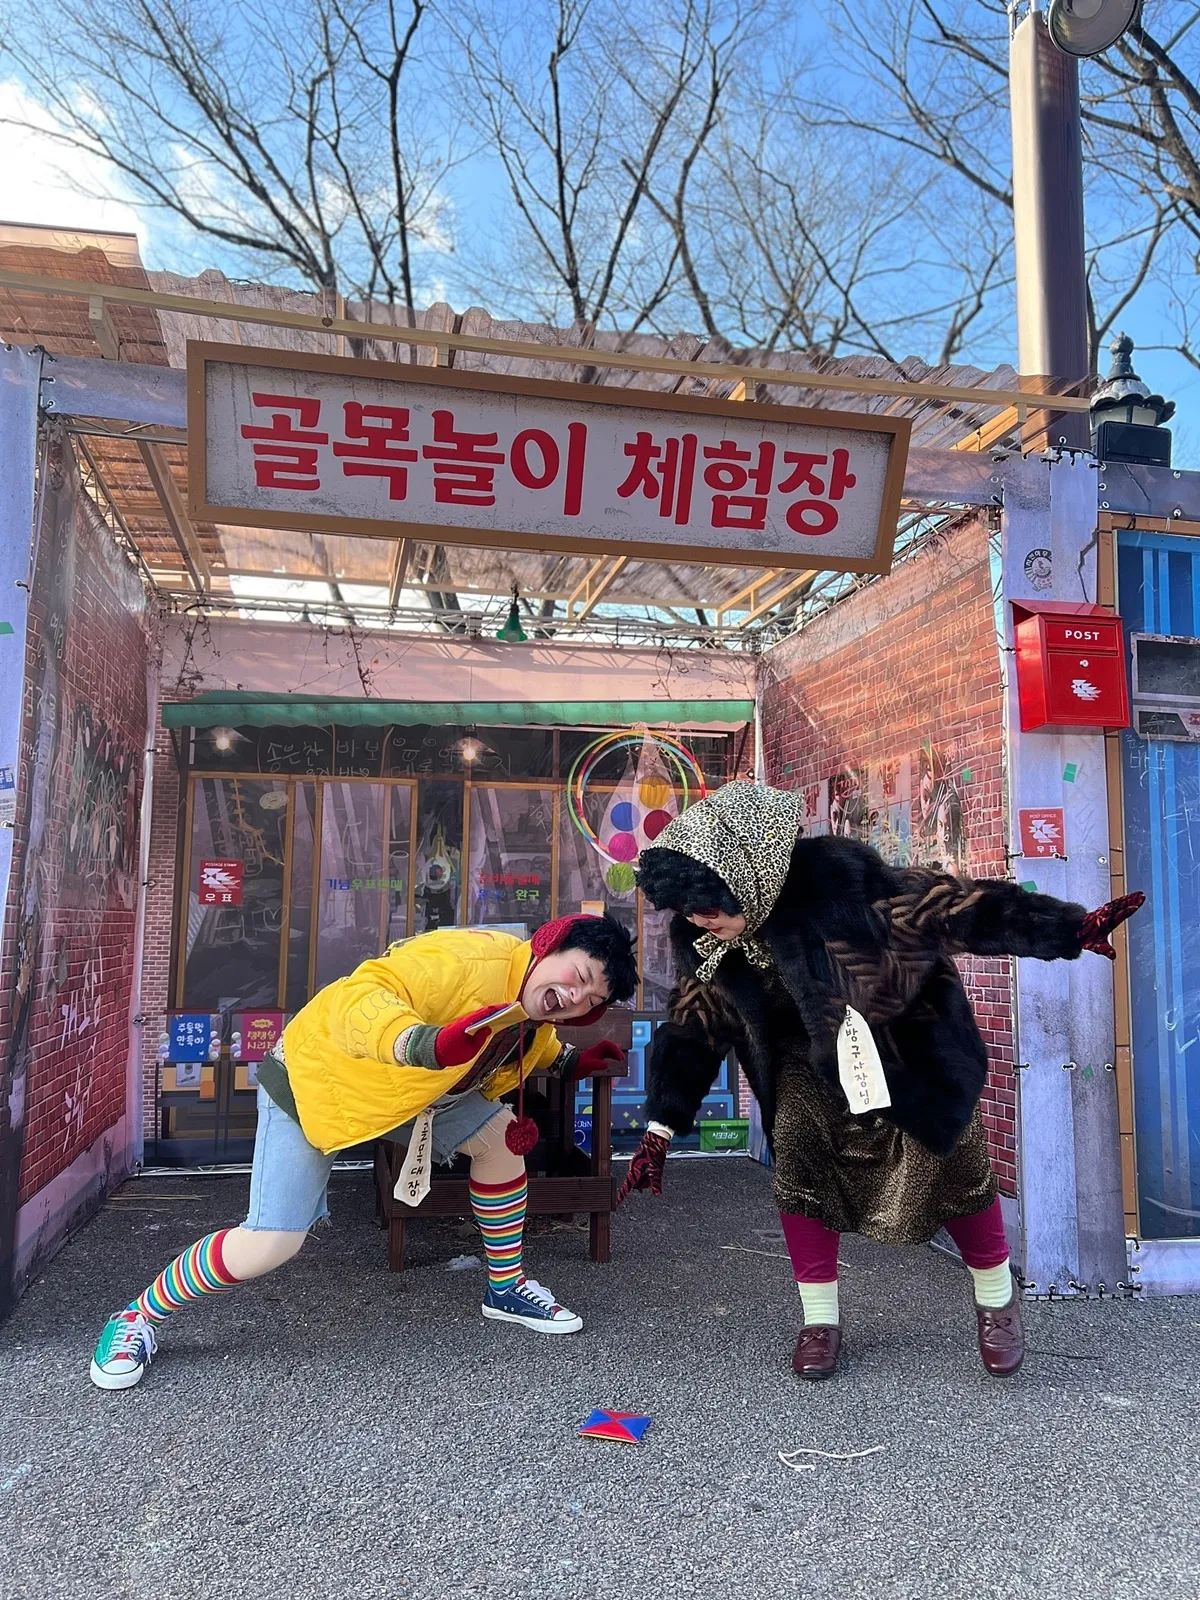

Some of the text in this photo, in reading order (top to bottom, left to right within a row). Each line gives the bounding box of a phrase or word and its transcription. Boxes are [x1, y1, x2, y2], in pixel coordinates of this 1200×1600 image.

[240, 391, 857, 536] 골목놀이 체험장
[1065, 629, 1100, 641] POST
[336, 738, 379, 761] 바보
[1036, 845, 1057, 853] 우표
[205, 893, 232, 902] 우표
[515, 889, 540, 901] 완구
[712, 1132, 739, 1140] GREEN
[407, 1122, 429, 1198] 골목대장
